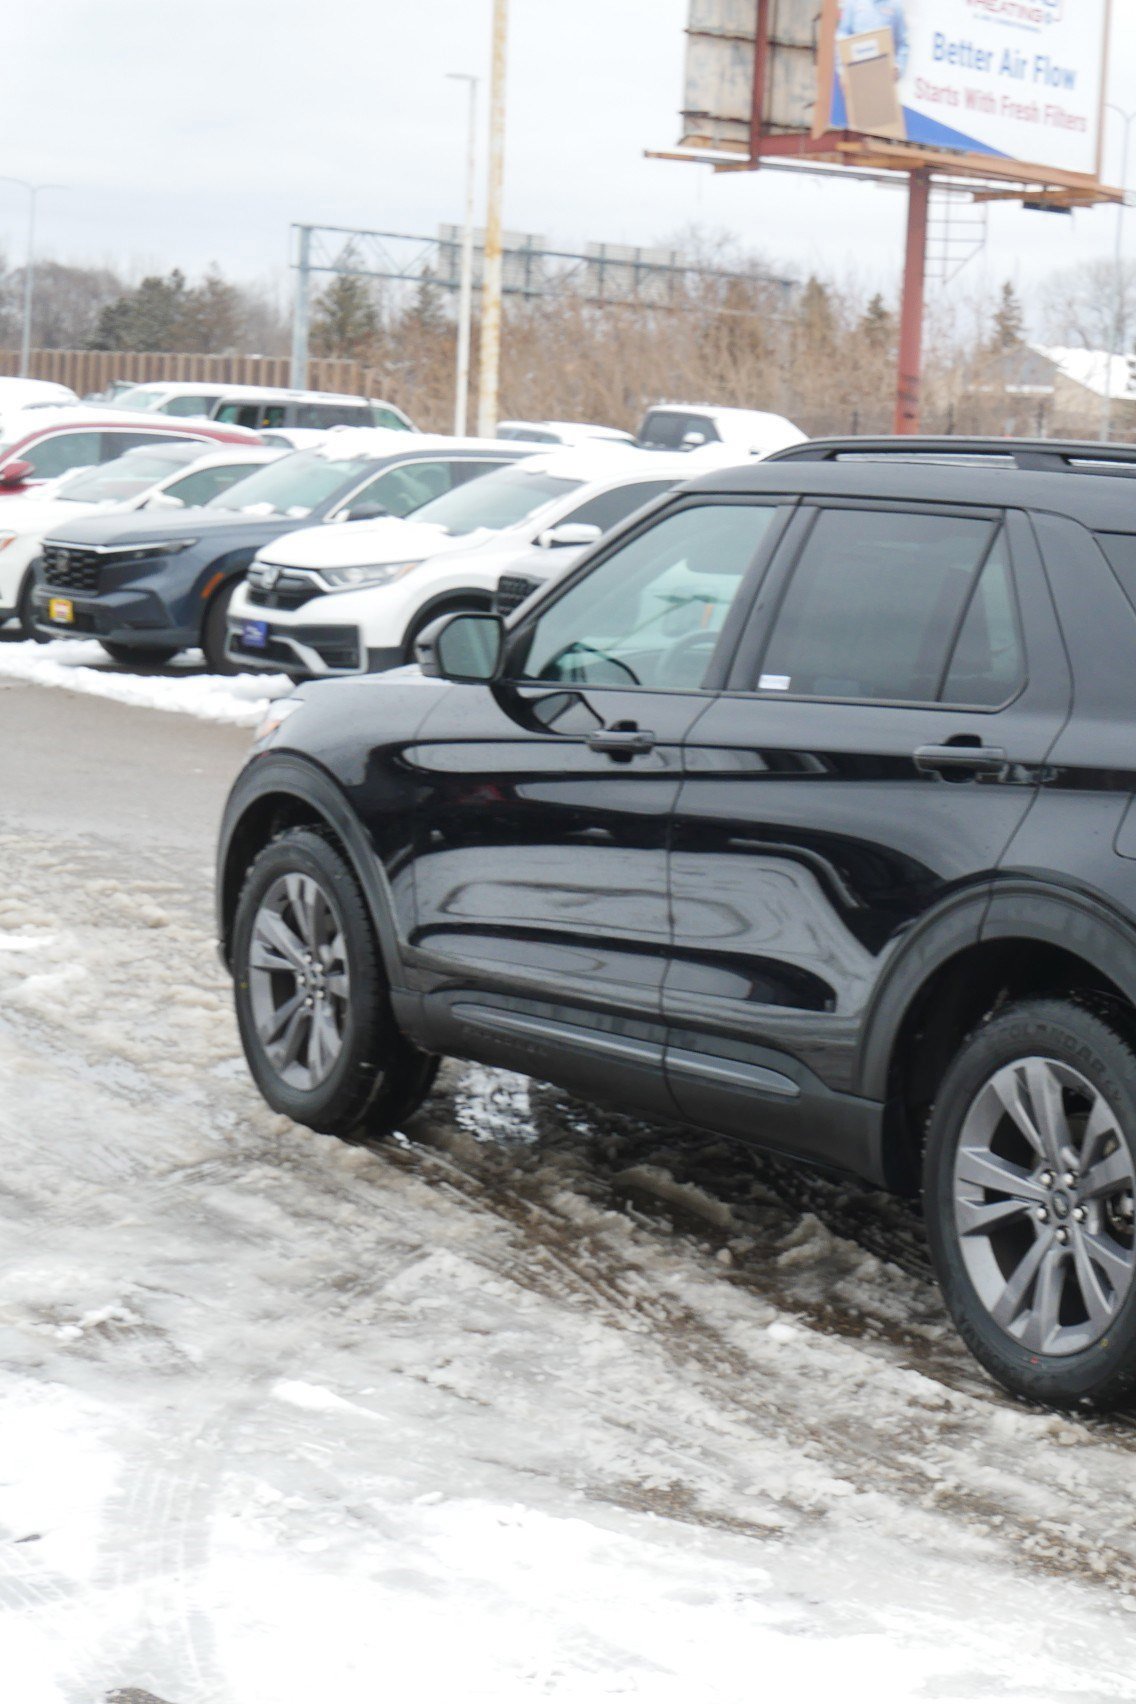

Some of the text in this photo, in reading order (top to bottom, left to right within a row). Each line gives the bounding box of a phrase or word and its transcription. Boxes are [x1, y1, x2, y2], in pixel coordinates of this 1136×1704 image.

[932, 31, 1077, 90] Better Air Flow
[914, 75, 1088, 133] Starts With Fresh Filters
